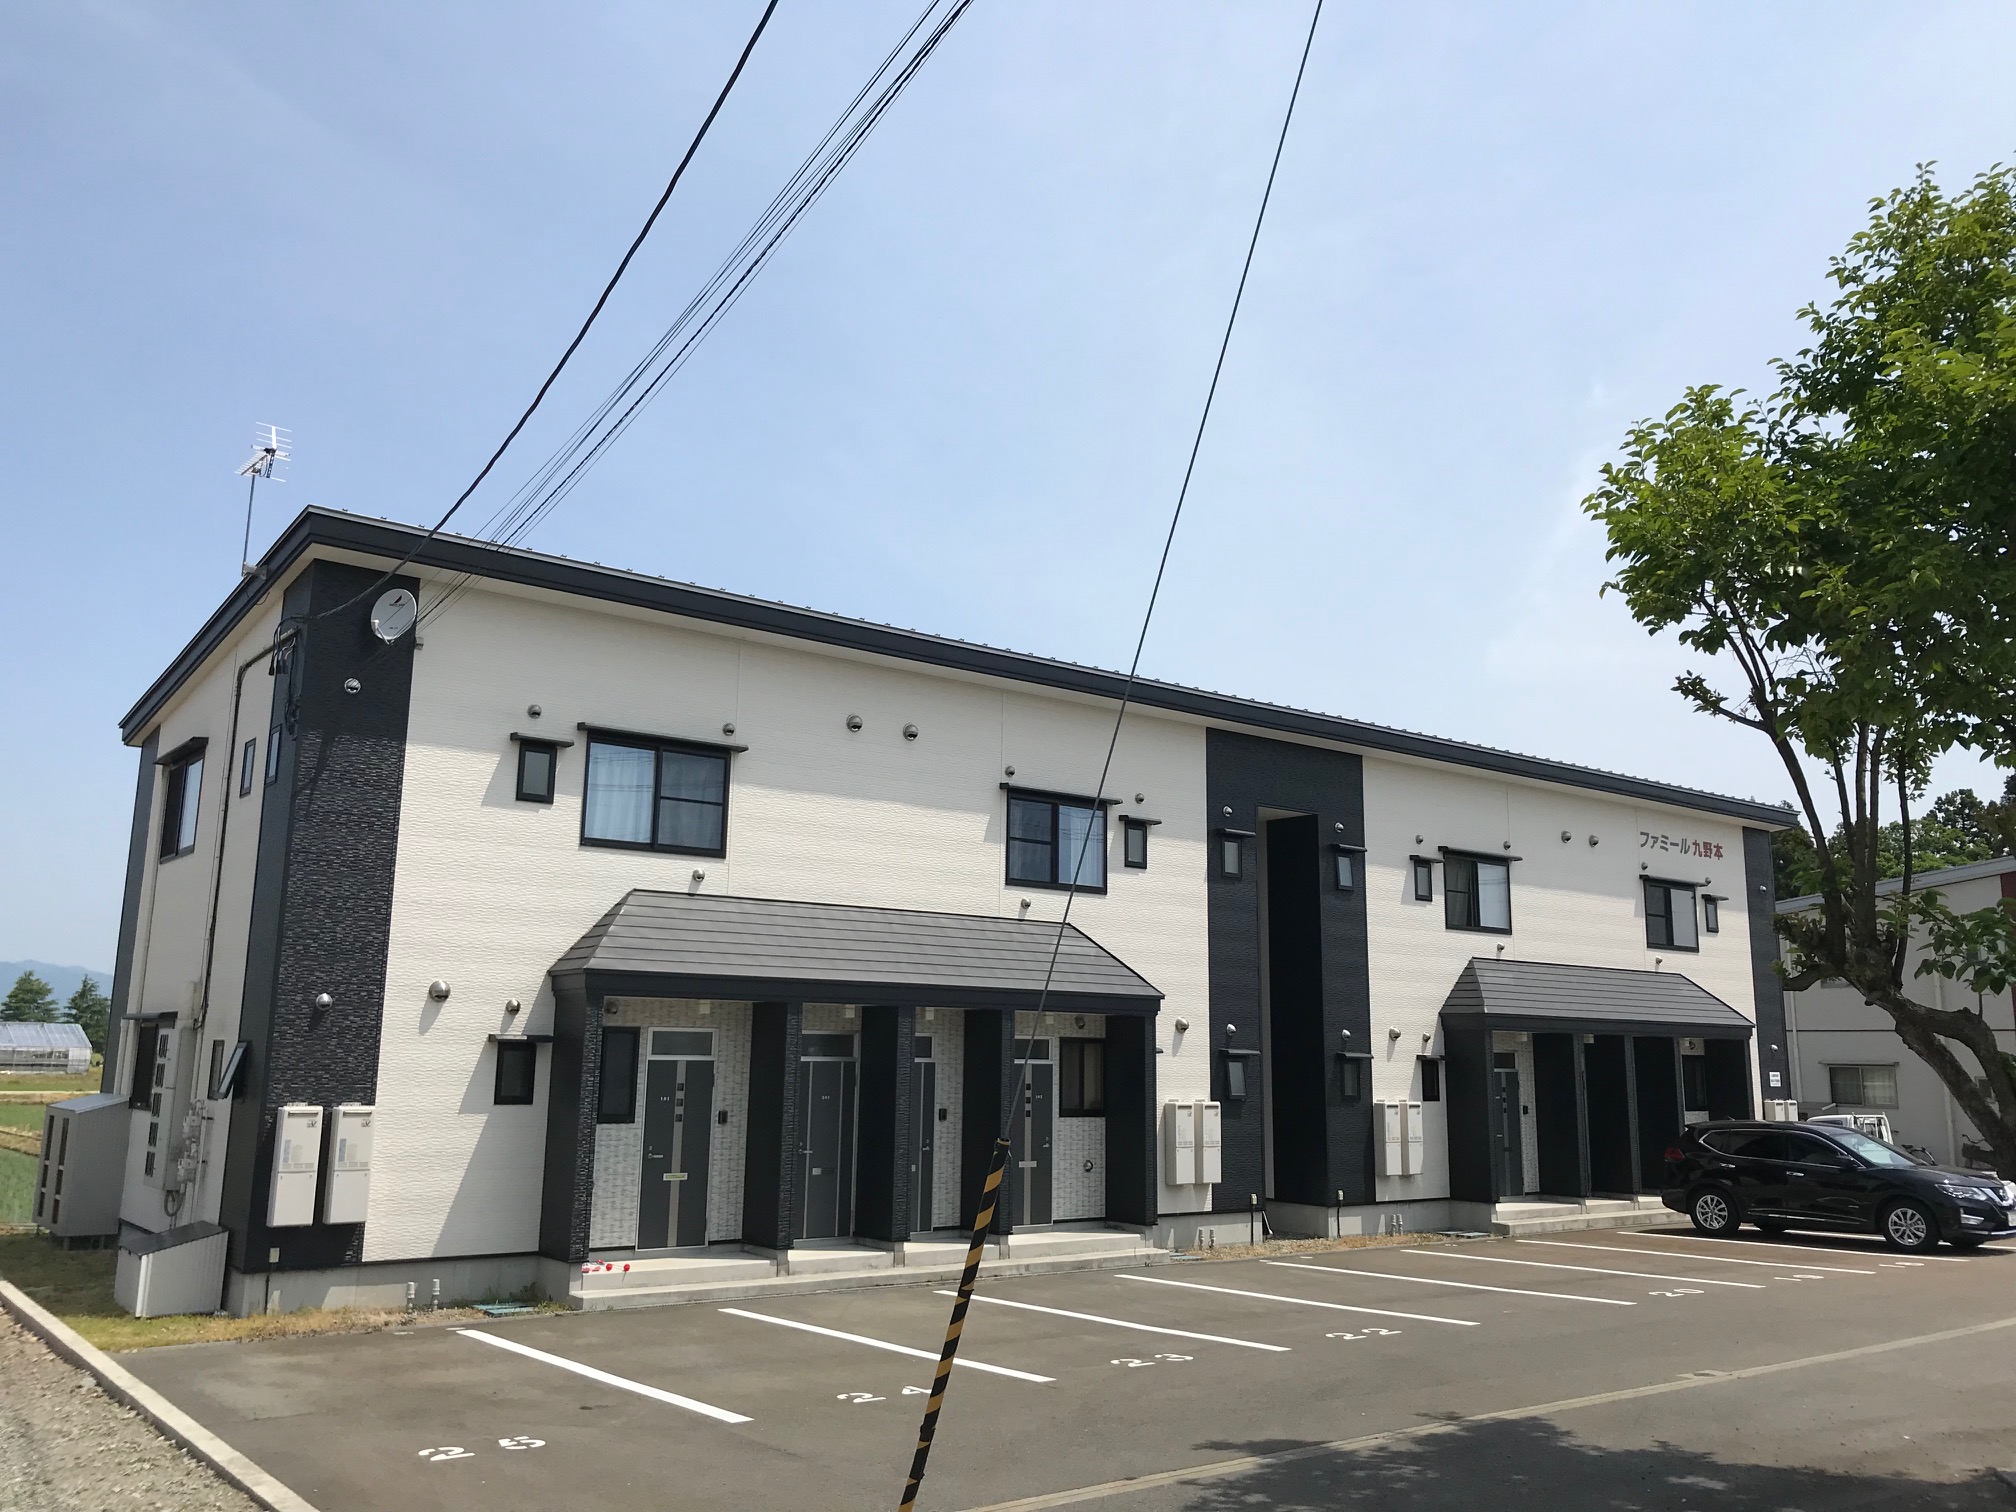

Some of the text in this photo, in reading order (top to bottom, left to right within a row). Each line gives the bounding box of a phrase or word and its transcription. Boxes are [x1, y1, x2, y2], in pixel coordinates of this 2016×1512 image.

[1640, 831, 1724, 860] ファミール九野本
[1648, 1288, 1705, 1297] 20
[1325, 1328, 1402, 1340] 22
